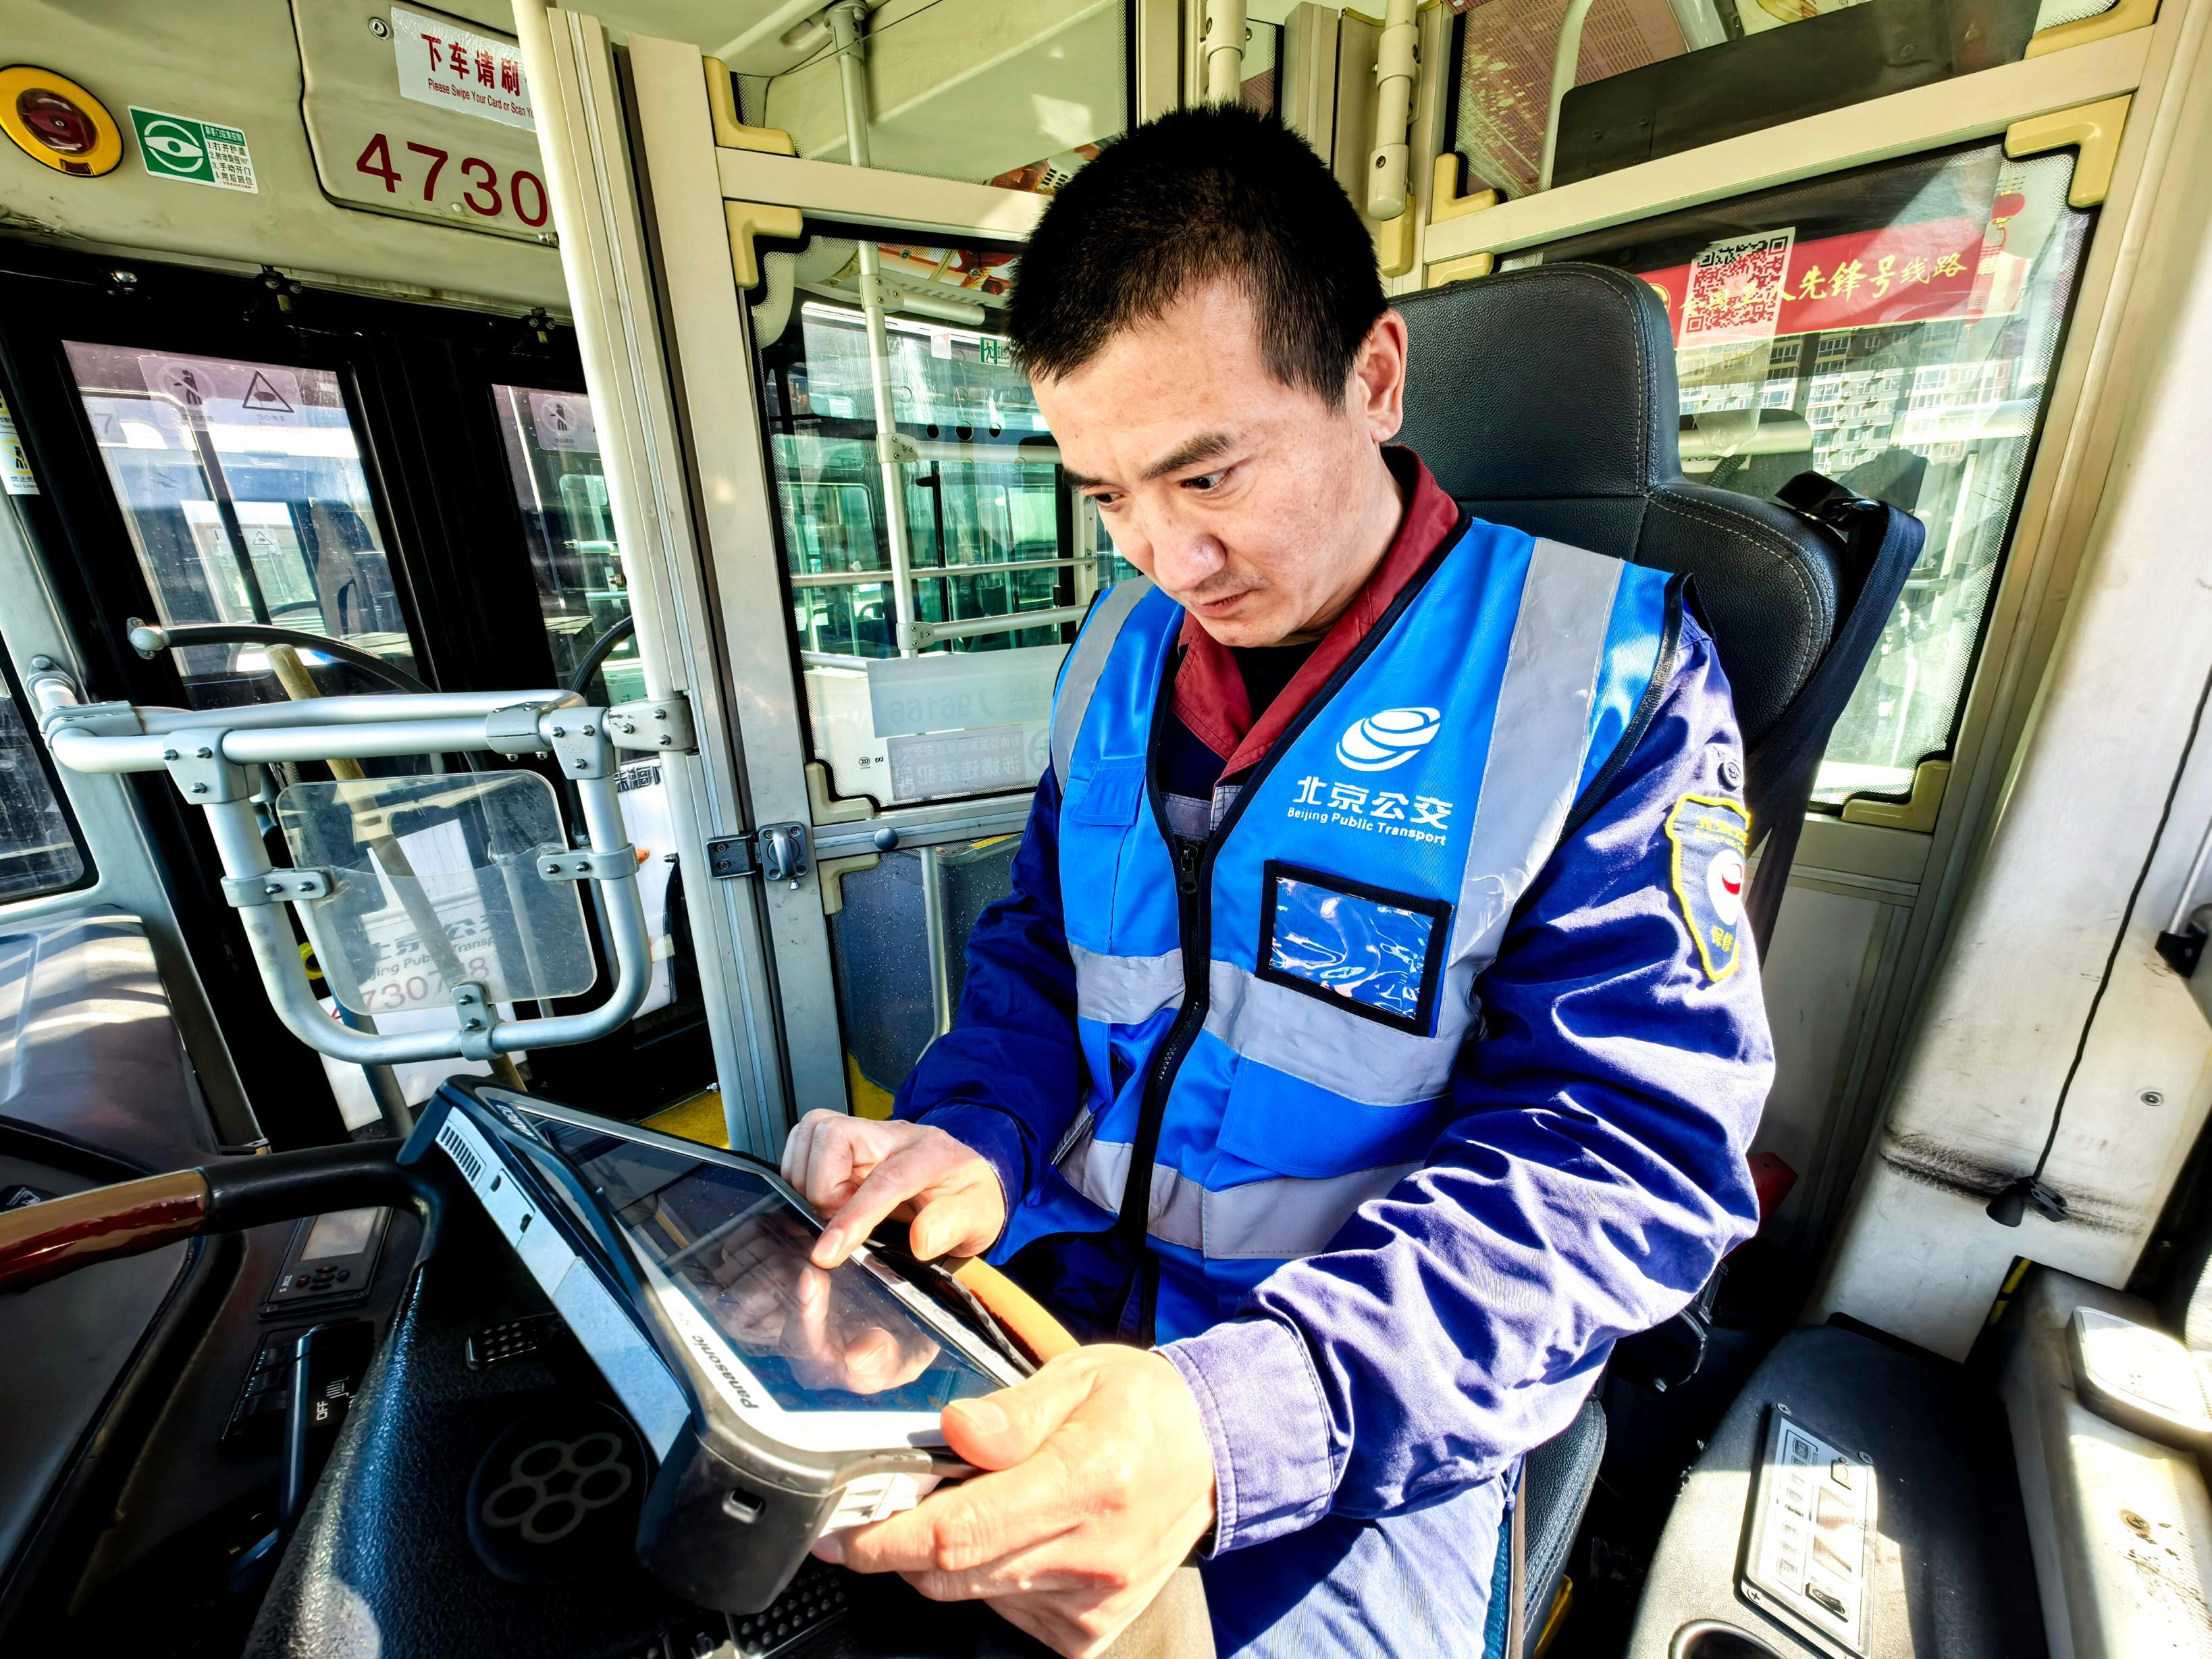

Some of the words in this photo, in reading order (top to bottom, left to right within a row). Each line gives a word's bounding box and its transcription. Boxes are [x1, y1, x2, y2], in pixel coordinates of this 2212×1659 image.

[421, 33, 527, 97] 下车请刷
[427, 78, 450, 95] Please
[451, 84, 470, 101] Swipe
[472, 91, 486, 104] Your
[488, 95, 502, 109] Card
[503, 102, 510, 111] or
[511, 102, 525, 116] Scan
[356, 132, 548, 228] 4730
[1287, 806, 1329, 824] Beijing
[1331, 812, 1374, 832] Public
[1376, 821, 1448, 846] Transport
[1292, 775, 1454, 831] 北京公交
[691, 1333, 759, 1409] Panasonic
[315, 1400, 329, 1421] OFF
